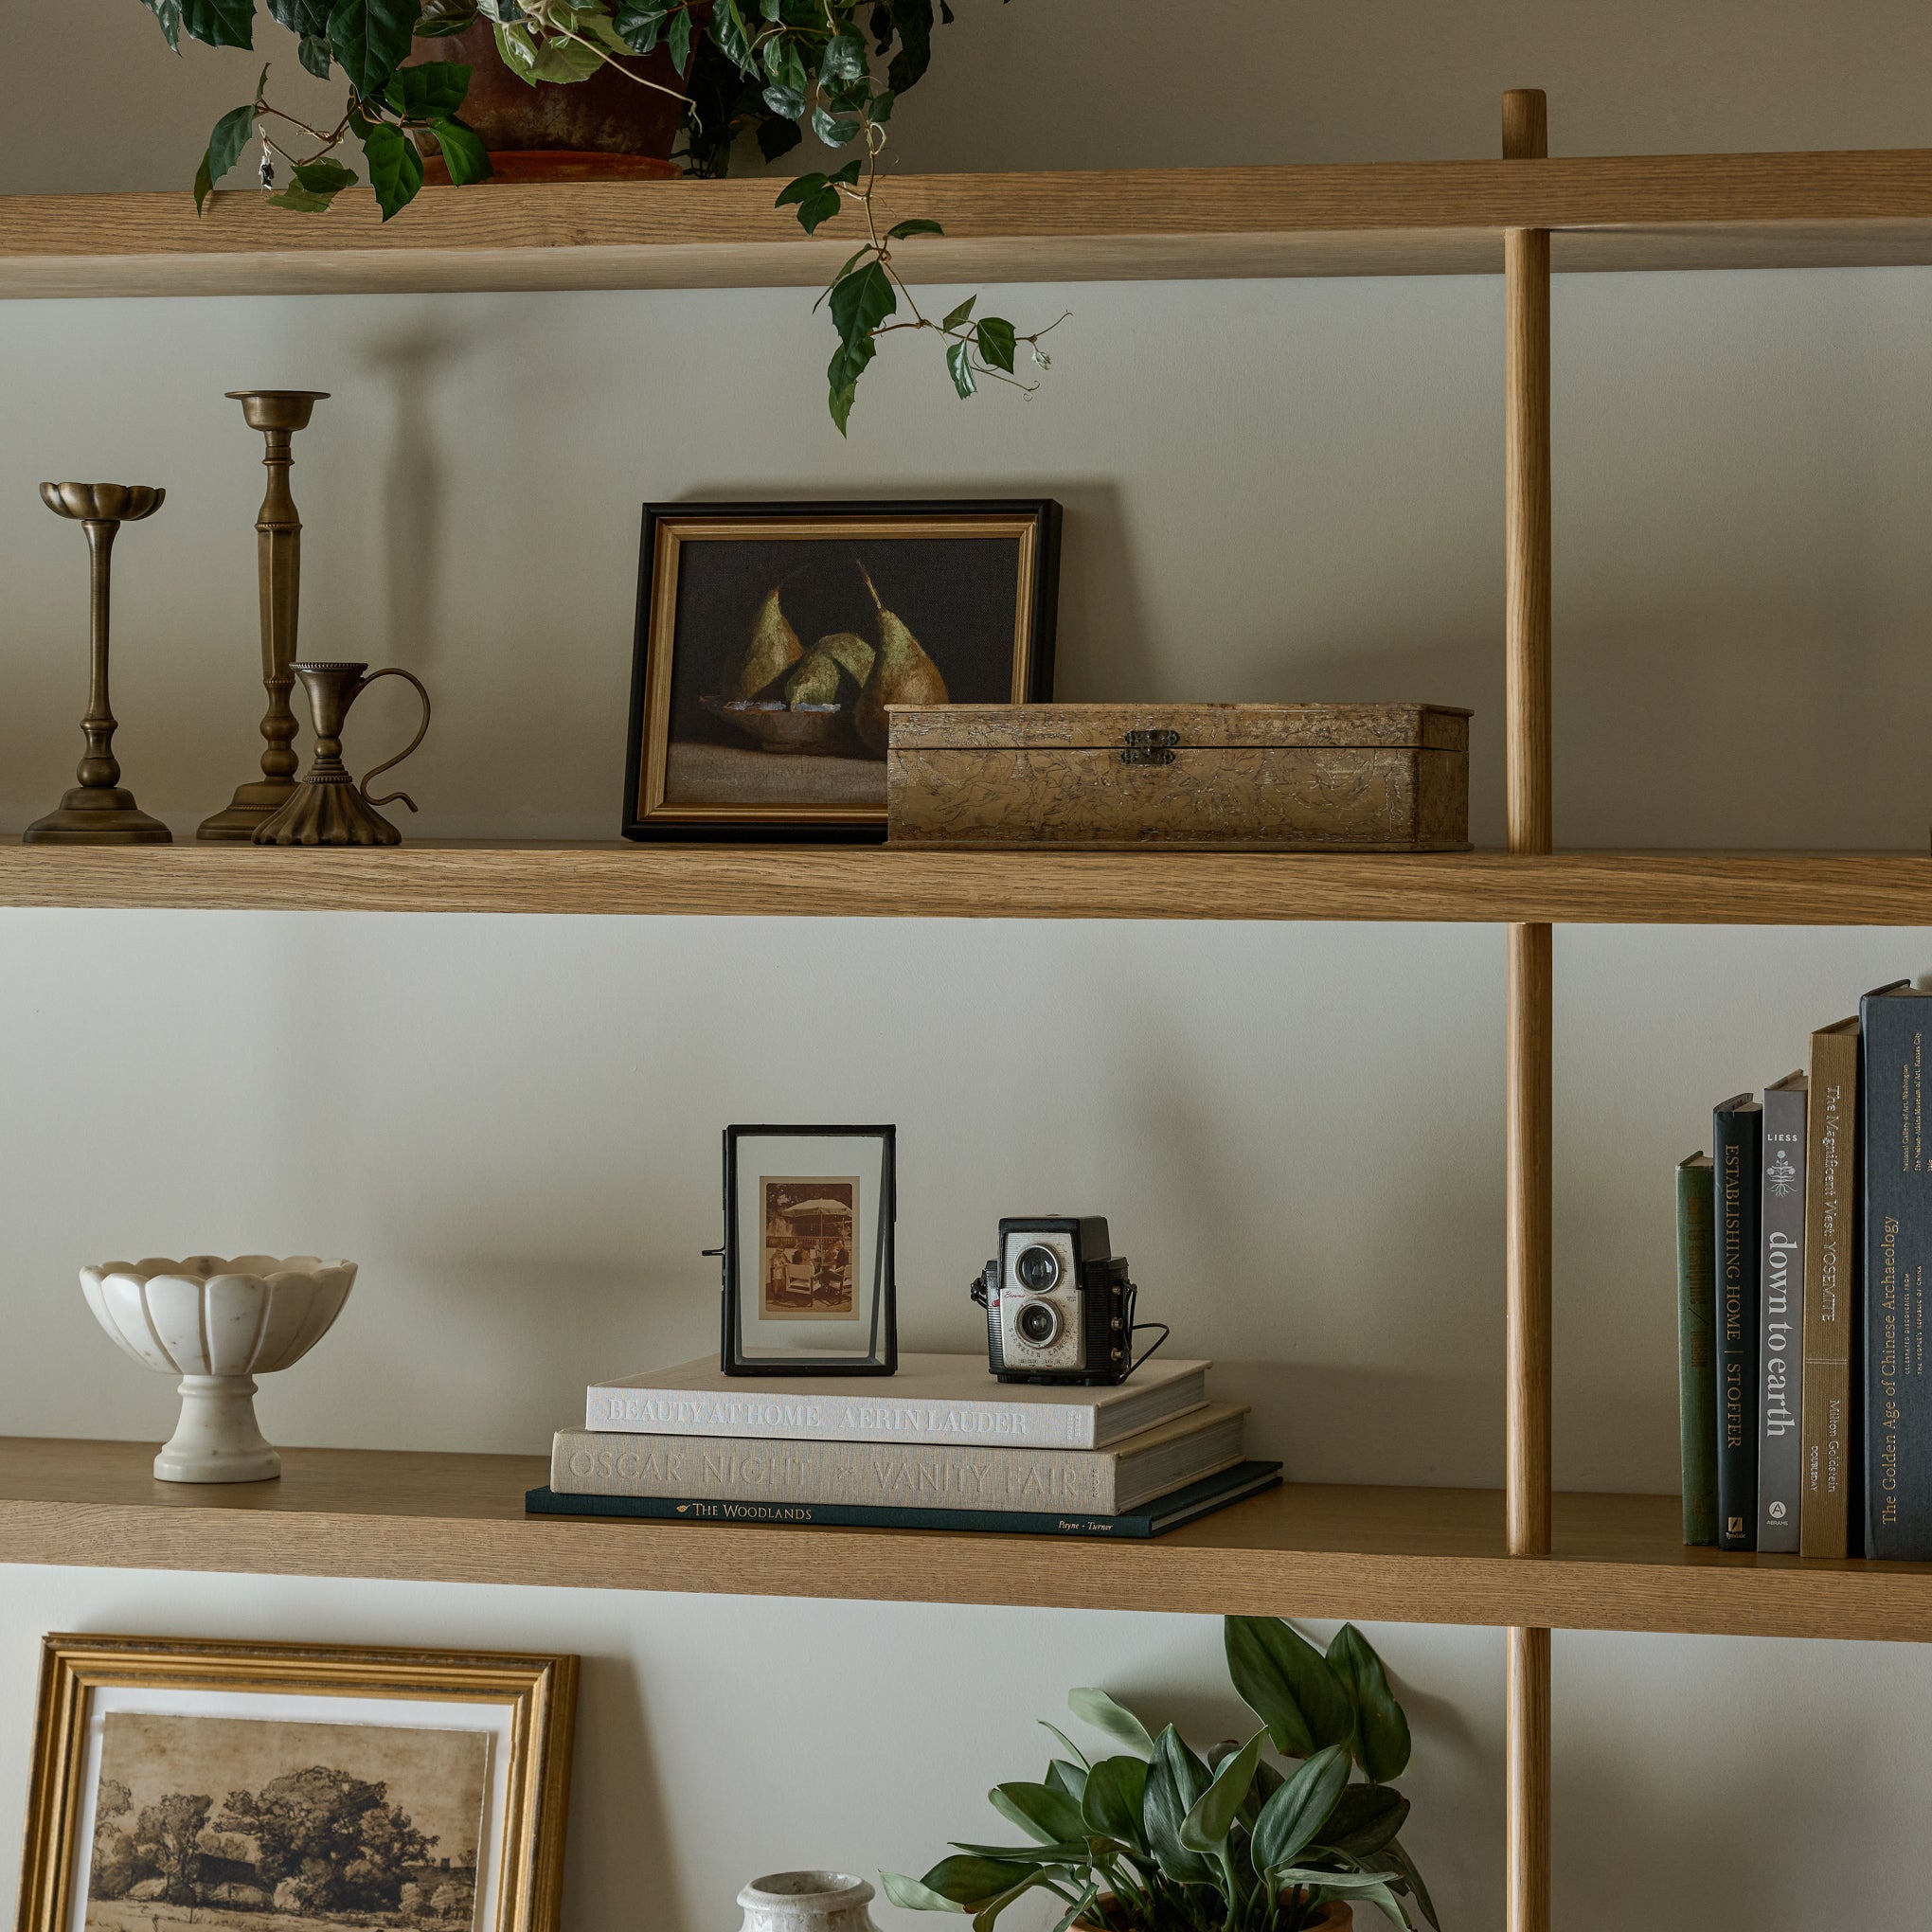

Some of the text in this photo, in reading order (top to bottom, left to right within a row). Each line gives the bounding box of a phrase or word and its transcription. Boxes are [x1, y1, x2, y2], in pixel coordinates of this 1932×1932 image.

[1767, 1134, 1798, 1142] LIESS
[1822, 1085, 1840, 1322] The Magnificent West: YOSEMITE
[1725, 1144, 1743, 1449] ESTABLISHING HOME STOFFER
[1766, 1231, 1798, 1438] down to earth
[1880, 1216, 1900, 1525] The Golden Age of Chinese Archaeology
[608, 1399, 1030, 1436] BEAUTY AT HOME AERIN LAUDER
[1810, 1445, 1818, 1493] DOUBLEDAY
[1828, 1399, 1840, 1493] Milton Goldstein
[568, 1450, 1080, 1496] OSCAR NIGHT VANITY FAIR
[692, 1503, 813, 1520] THE WOODLANDS
[1058, 1520, 1080, 1531] Payne
[1087, 1521, 1114, 1530] Turner
[1726, 1531, 1746, 1540] Tyndale
